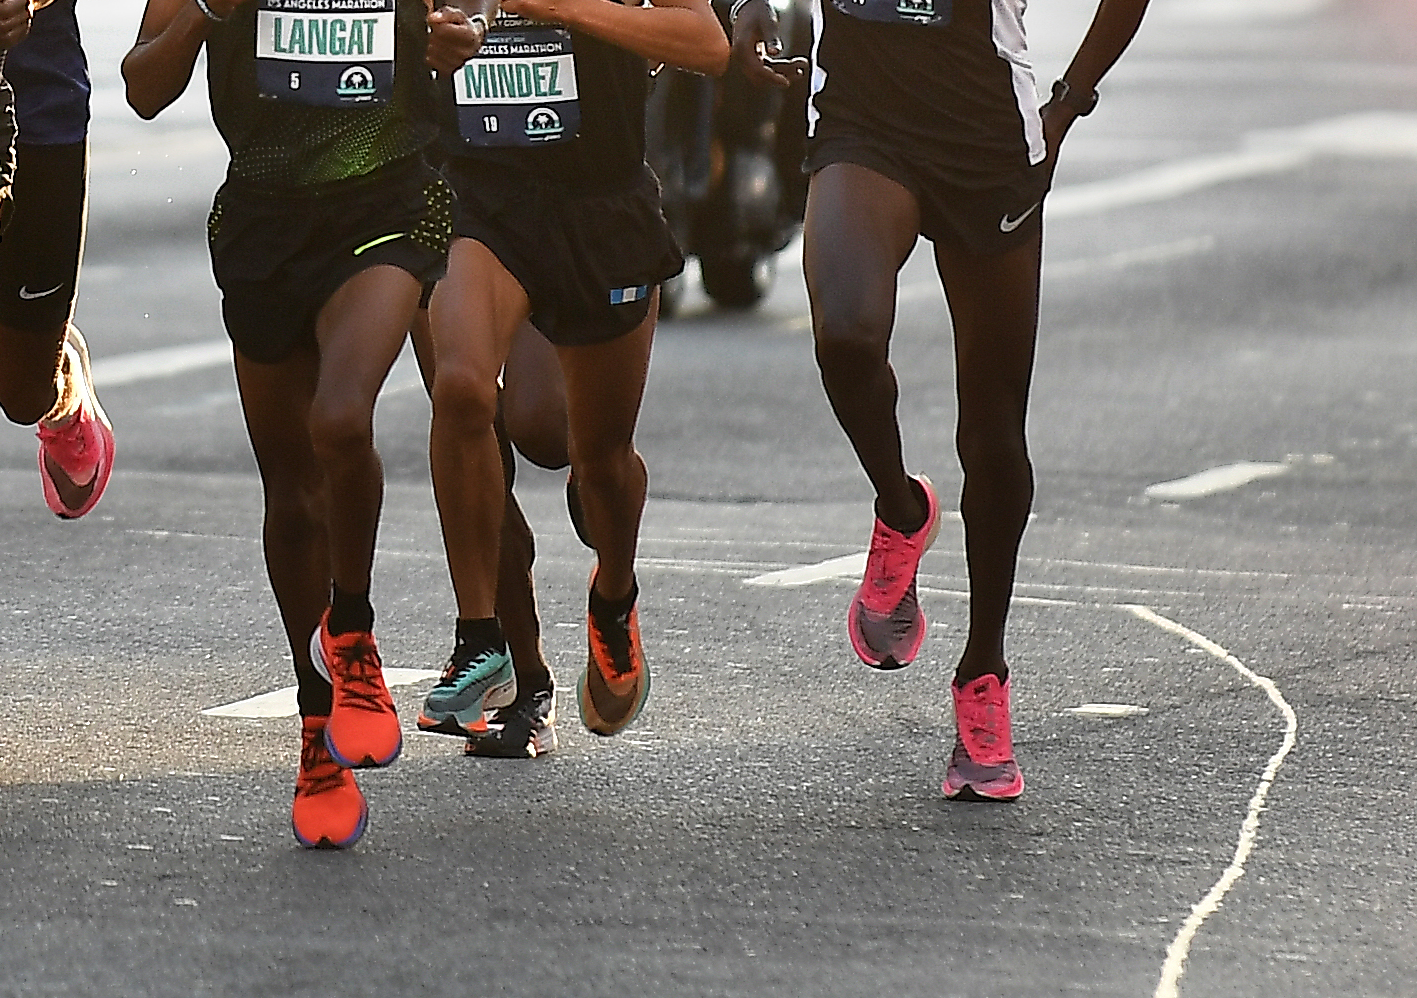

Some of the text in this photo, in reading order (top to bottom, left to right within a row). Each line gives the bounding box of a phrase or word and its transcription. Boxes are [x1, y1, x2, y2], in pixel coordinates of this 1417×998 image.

[274, 17, 379, 55] LANGAT
[479, 42, 563, 55] GELES MARATHON
[290, 72, 300, 89] 5
[464, 61, 563, 99] MINDEZ
